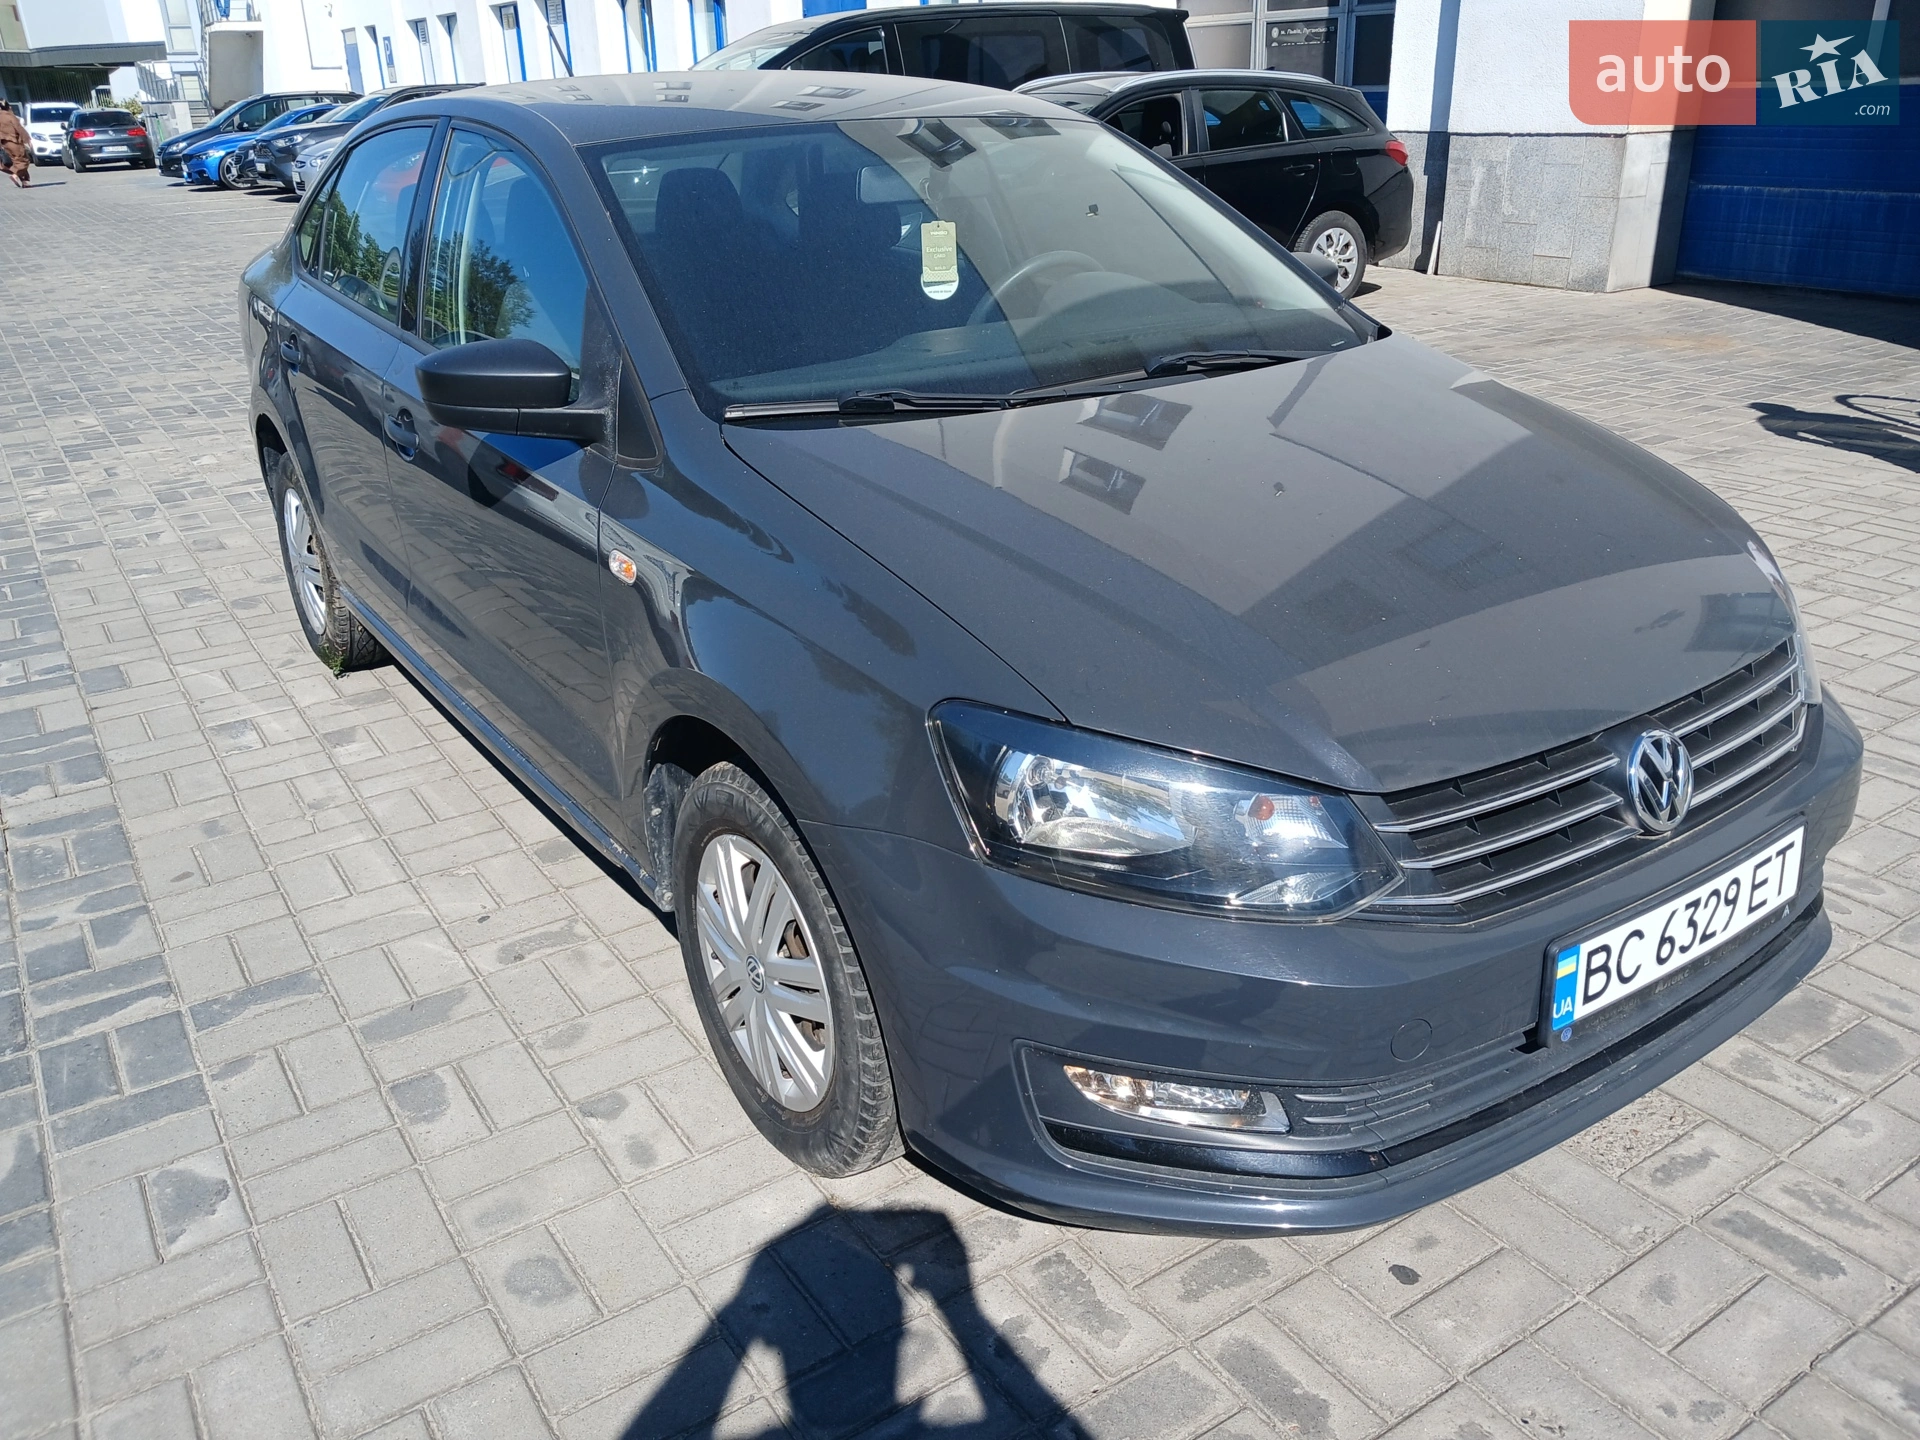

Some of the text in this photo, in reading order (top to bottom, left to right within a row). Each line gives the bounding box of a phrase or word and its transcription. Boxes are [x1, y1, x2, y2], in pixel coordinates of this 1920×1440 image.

[1582, 840, 1796, 1006] BC 6329 ET
[1553, 996, 1573, 1018] UA
